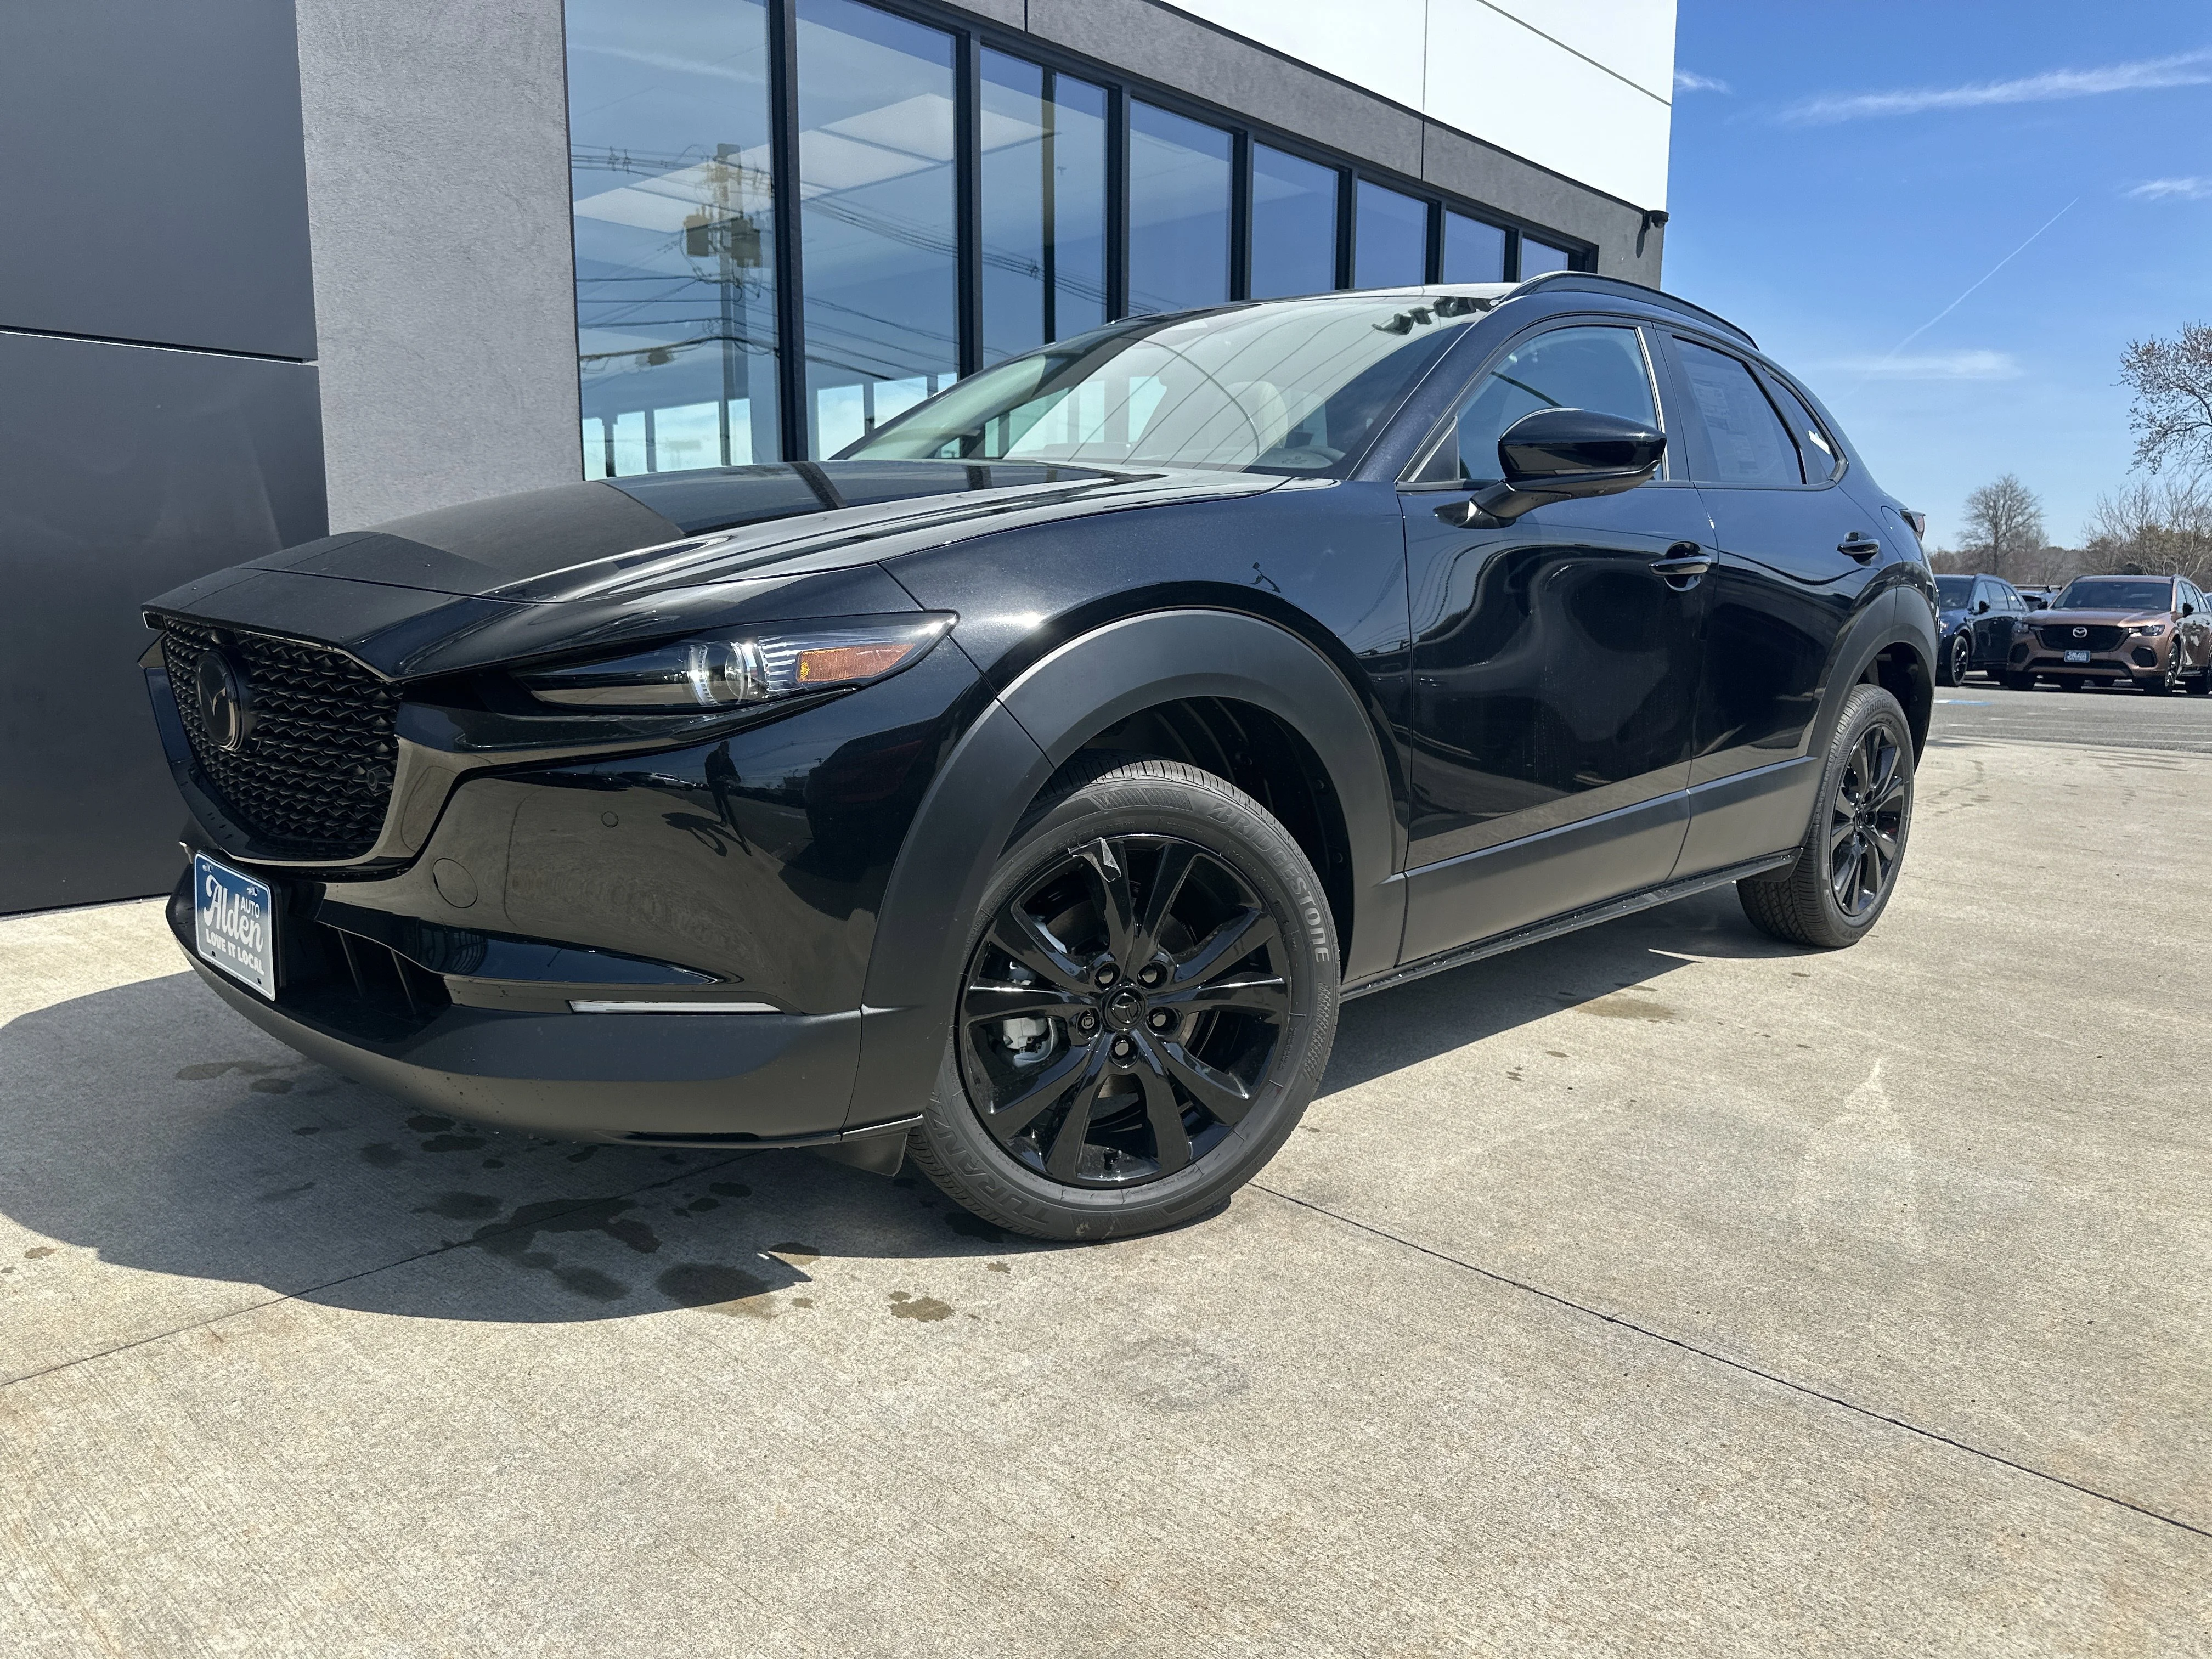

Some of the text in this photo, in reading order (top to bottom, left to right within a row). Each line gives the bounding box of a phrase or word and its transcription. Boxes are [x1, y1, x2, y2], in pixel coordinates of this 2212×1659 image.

[204, 874, 263, 952] Alden
[240, 896, 260, 918] AUTO
[1207, 802, 1330, 962] BRIDGESTONE
[206, 928, 264, 975] LOVE IT LOCAL
